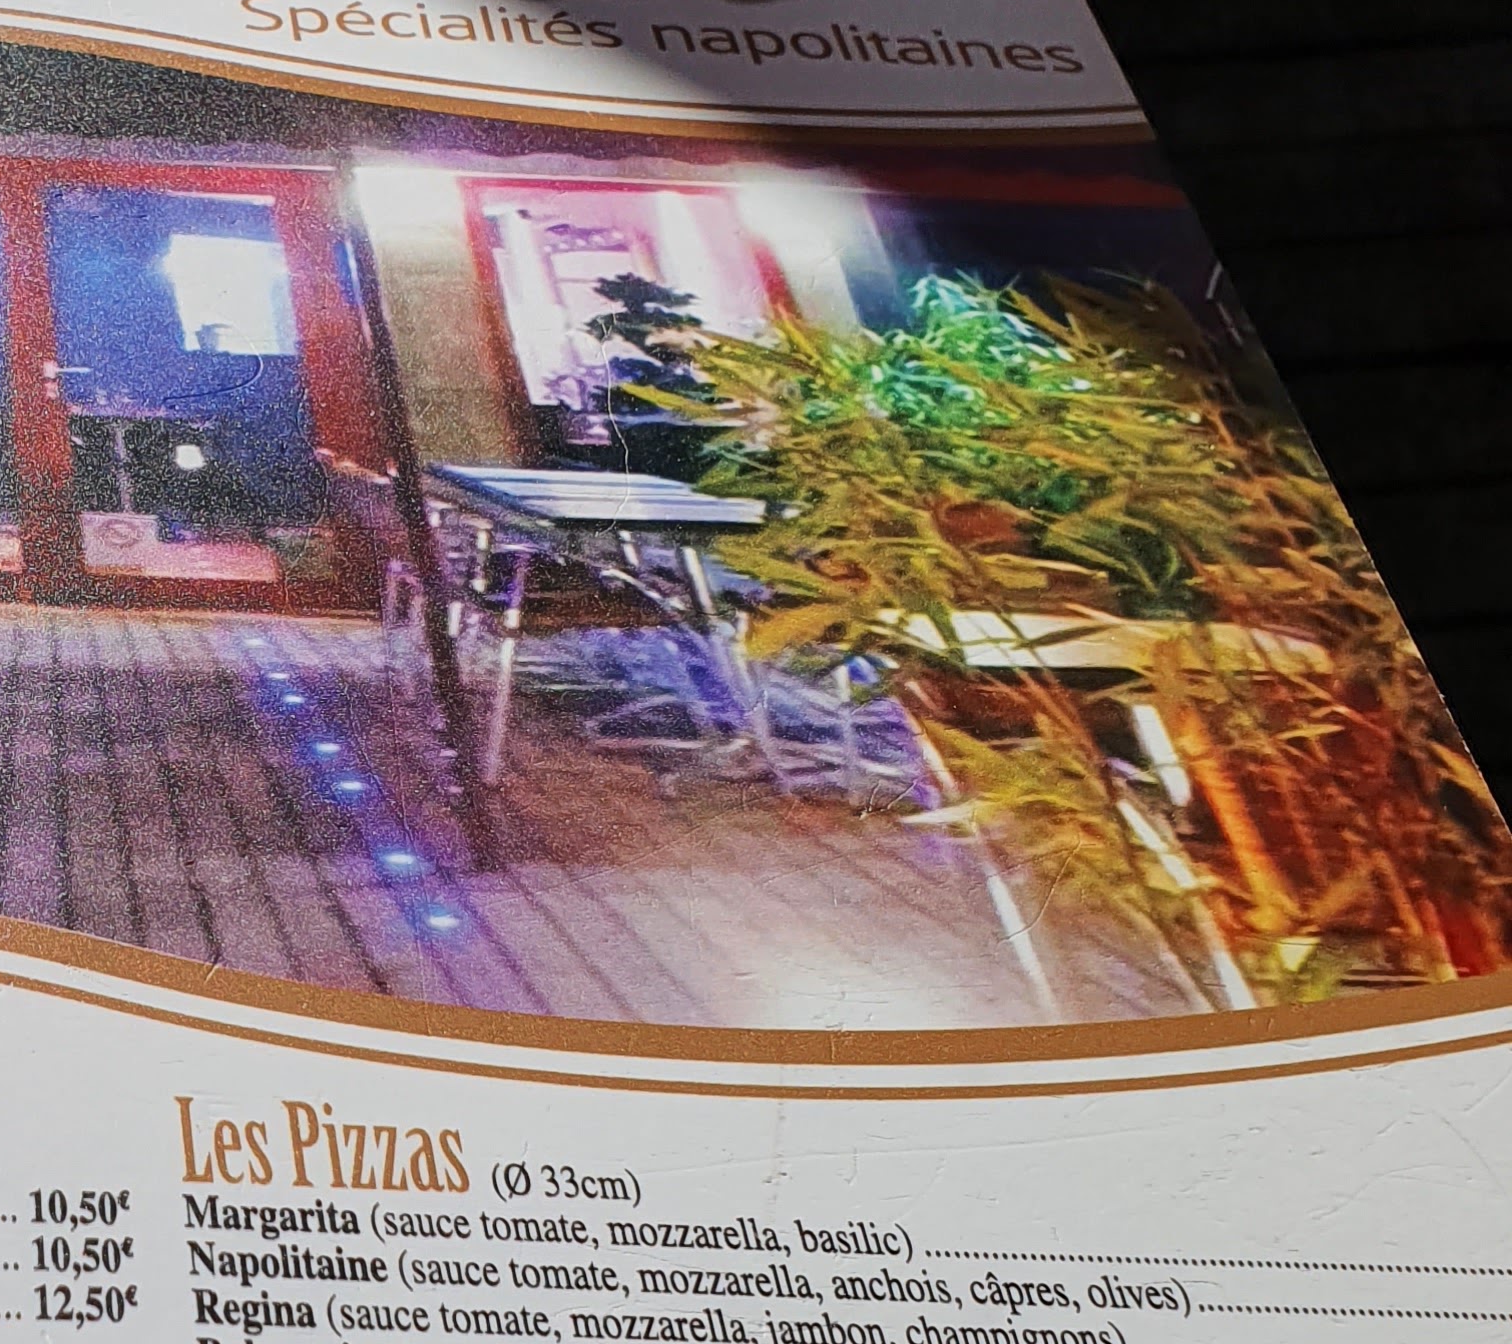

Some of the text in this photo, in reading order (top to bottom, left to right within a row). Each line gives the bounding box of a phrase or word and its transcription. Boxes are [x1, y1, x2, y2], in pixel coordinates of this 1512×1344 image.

[651, 22, 1086, 76] napolitaines
[174, 1096, 274, 1187] Les
[282, 1096, 471, 1193] Pizzas
[541, 1165, 642, 1208] 33cm)
[31, 1190, 129, 1230] 10,50€
[183, 1194, 913, 1262] Margarita (sauce tomate, mozzarella, basilic)
[34, 1237, 133, 1279] 10,50€
[35, 1285, 137, 1328] 12,50€
